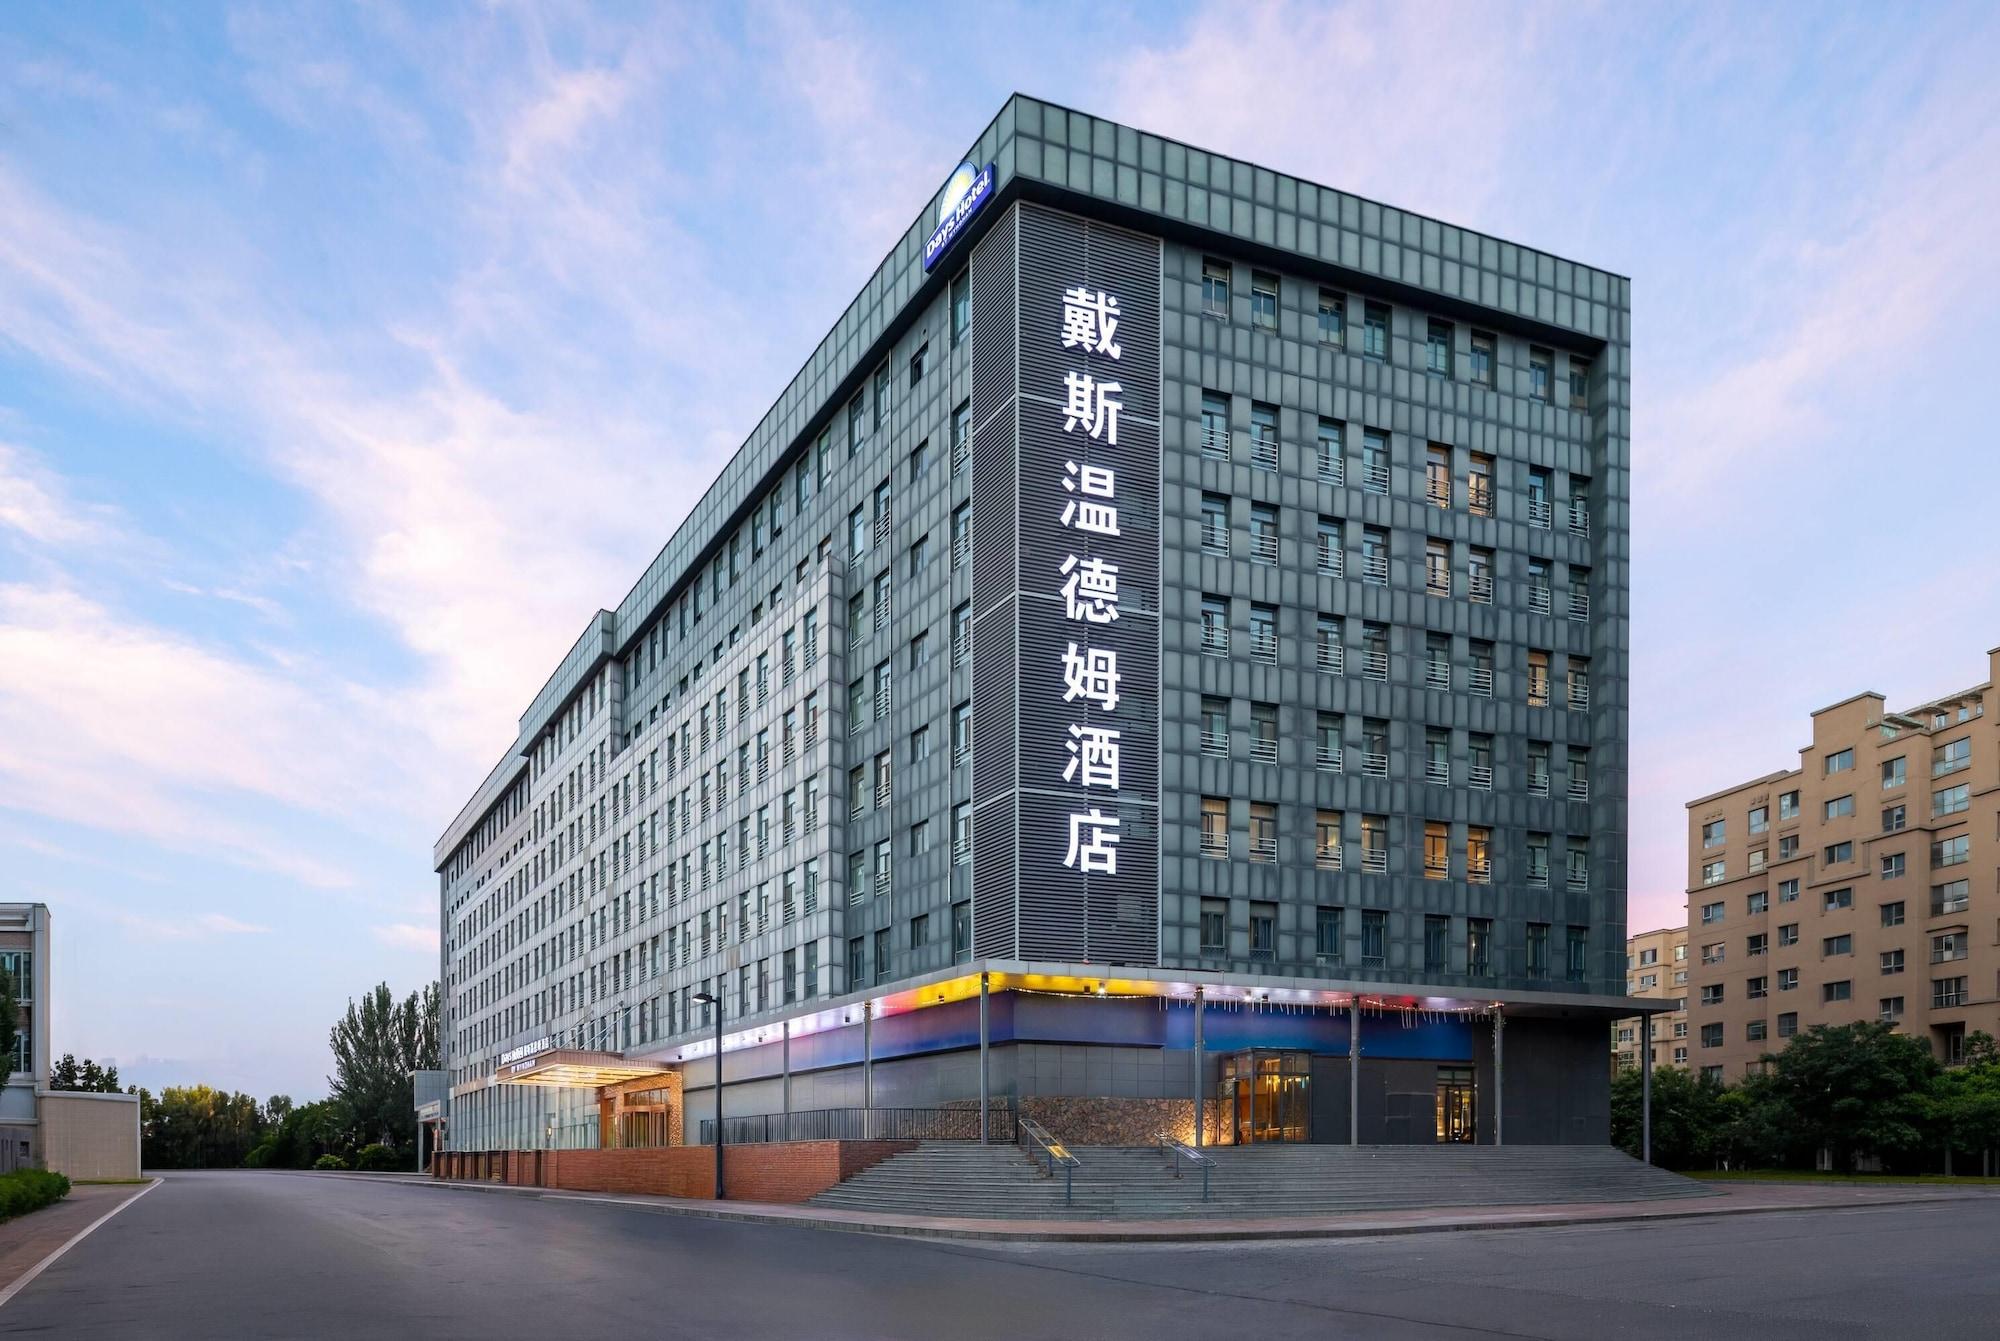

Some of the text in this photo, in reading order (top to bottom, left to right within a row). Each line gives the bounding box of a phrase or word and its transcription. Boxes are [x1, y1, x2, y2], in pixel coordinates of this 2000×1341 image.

[926, 170, 989, 259] Days Hotel
[1060, 287, 1122, 875] 戴斯温德姆酒店
